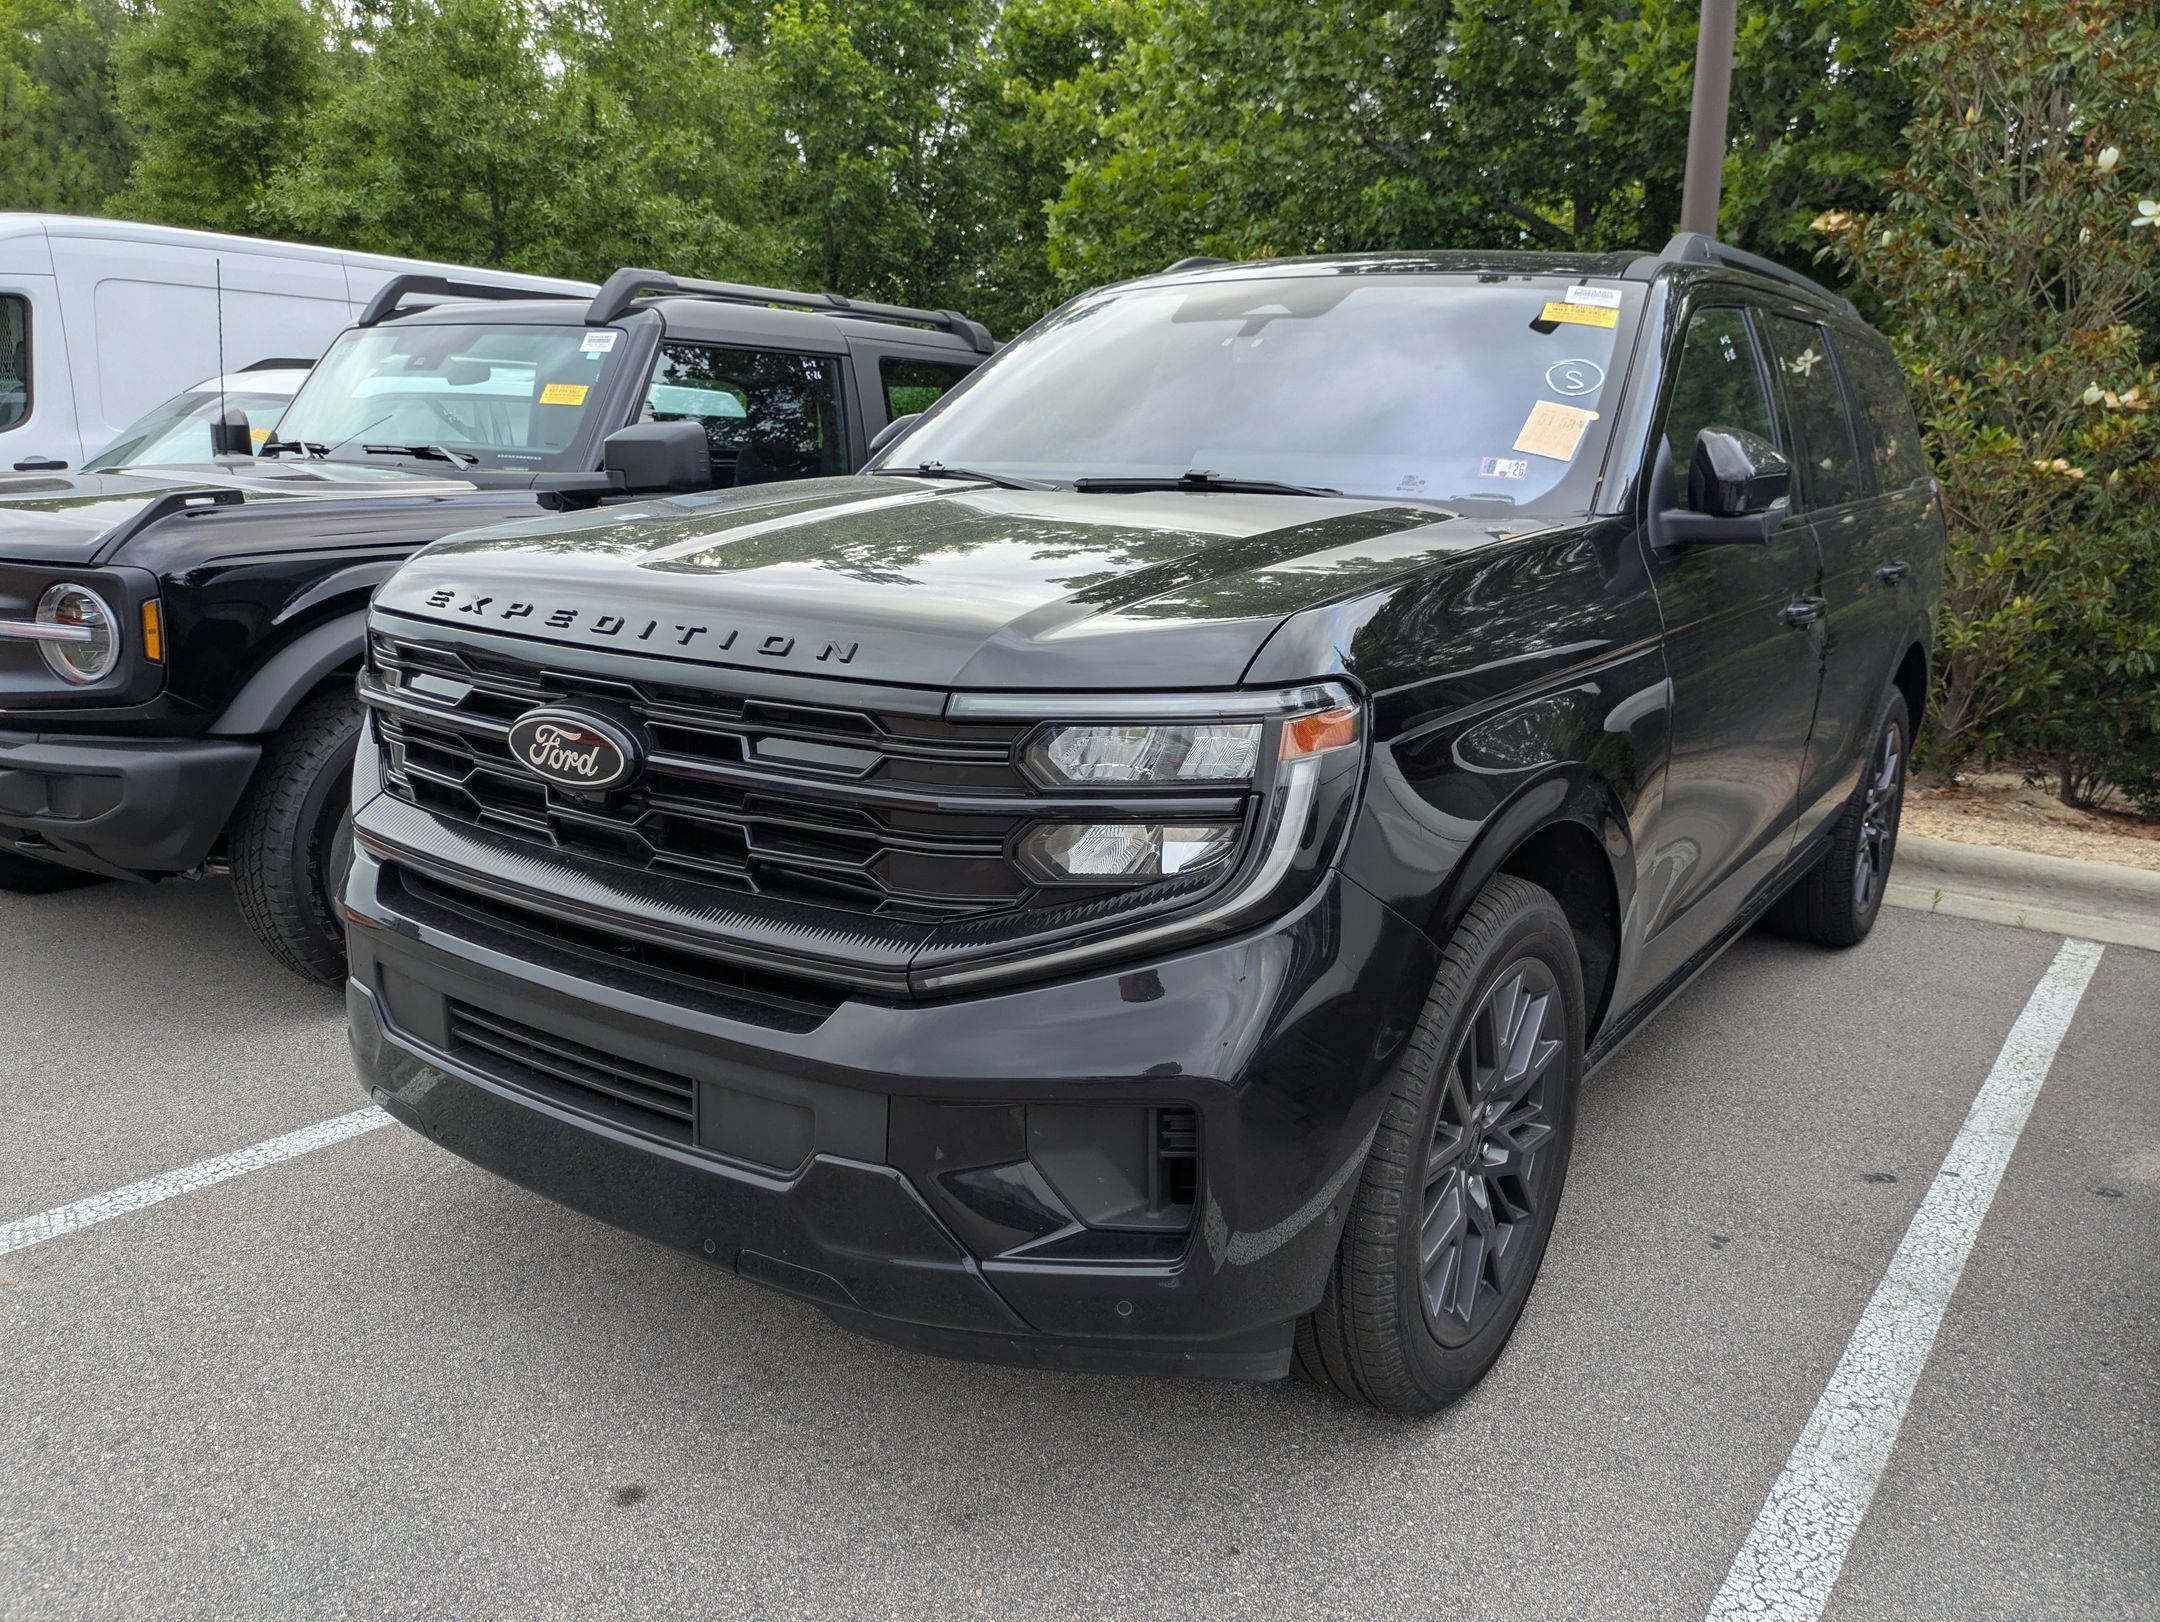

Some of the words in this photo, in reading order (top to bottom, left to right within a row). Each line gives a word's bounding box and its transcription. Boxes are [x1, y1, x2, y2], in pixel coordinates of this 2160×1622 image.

[1566, 370, 1584, 389] S
[1512, 462, 1525, 476] 26
[426, 590, 858, 664] EXPEDITION
[529, 724, 600, 777] Ford
